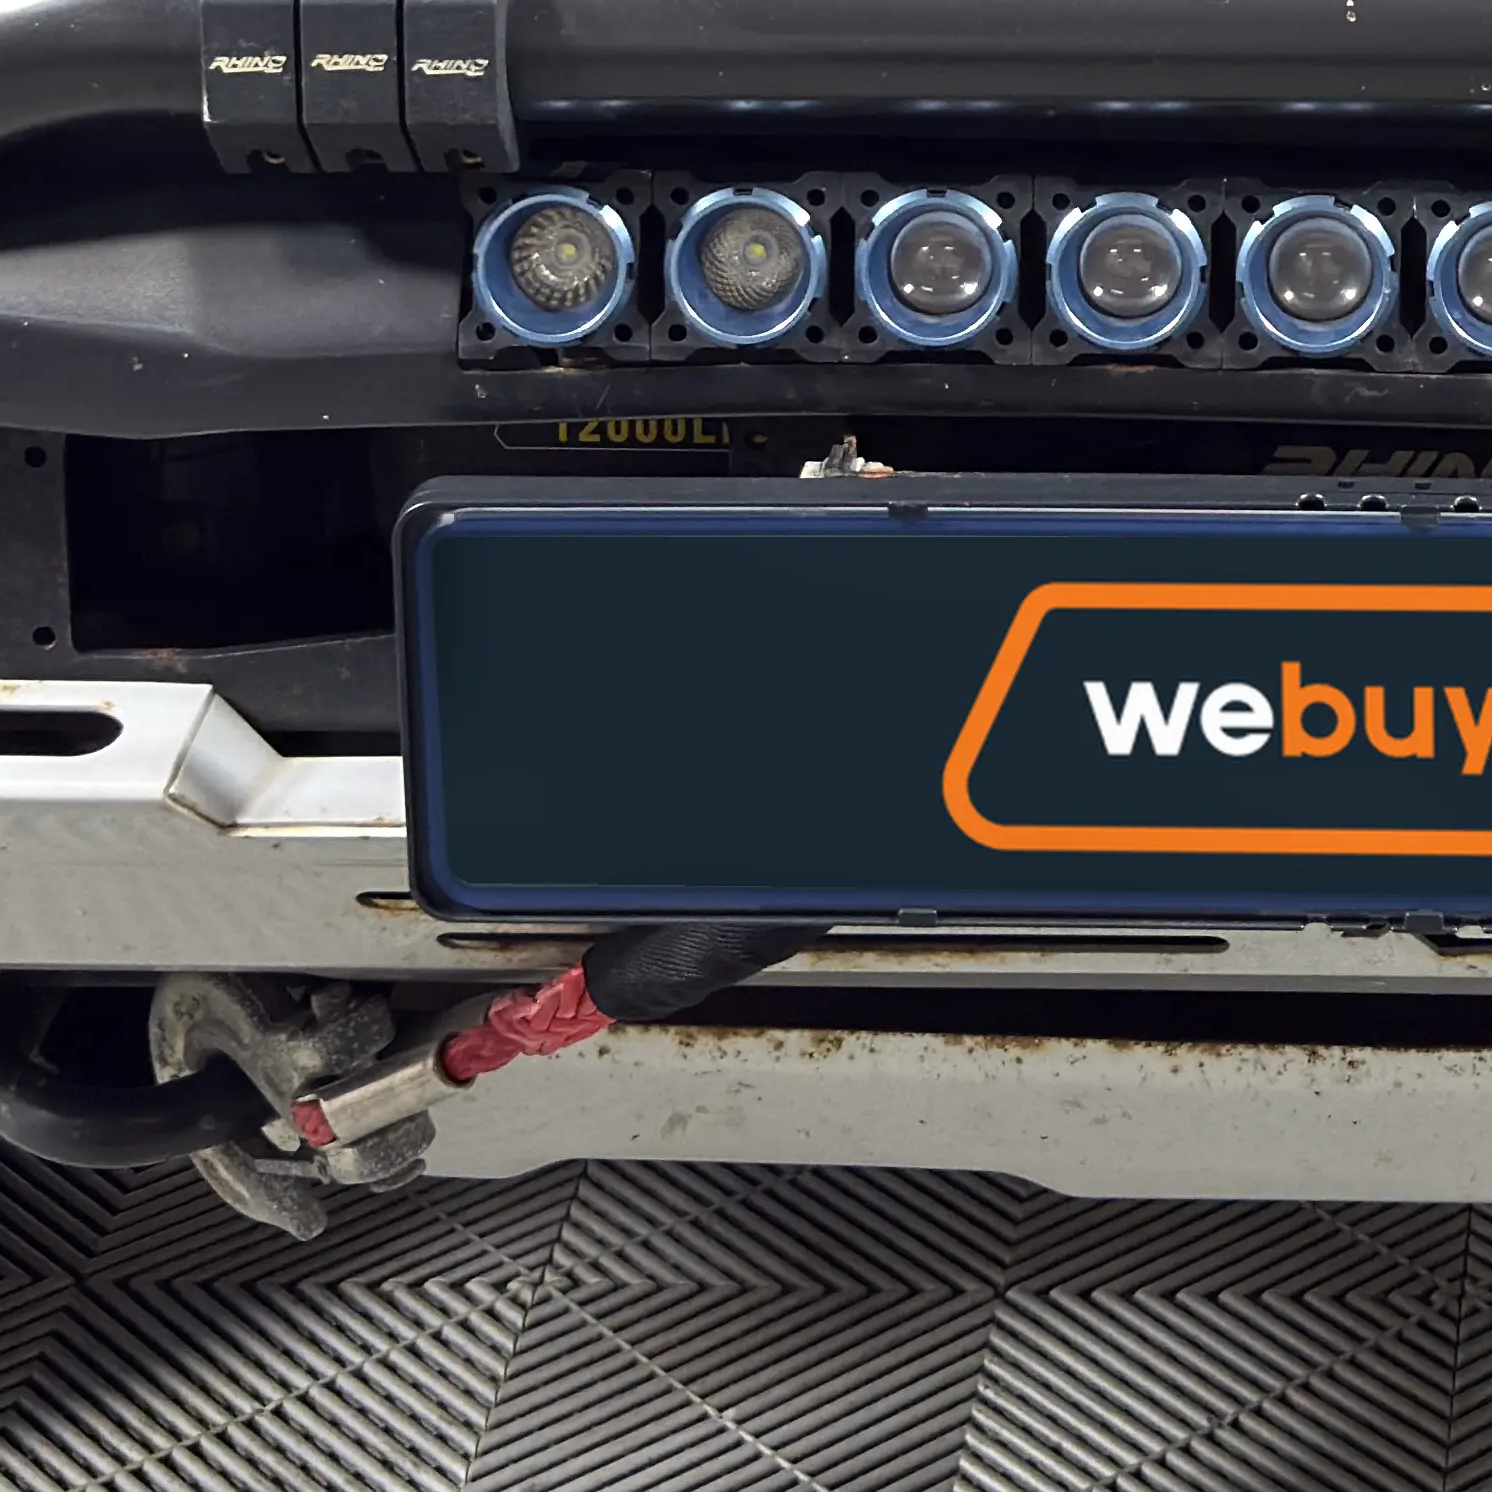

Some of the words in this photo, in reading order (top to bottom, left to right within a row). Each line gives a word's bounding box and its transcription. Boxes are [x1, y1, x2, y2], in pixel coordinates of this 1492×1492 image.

[209, 54, 288, 74] RHINO
[311, 53, 389, 72] RHINO
[411, 57, 489, 77] RHINO
